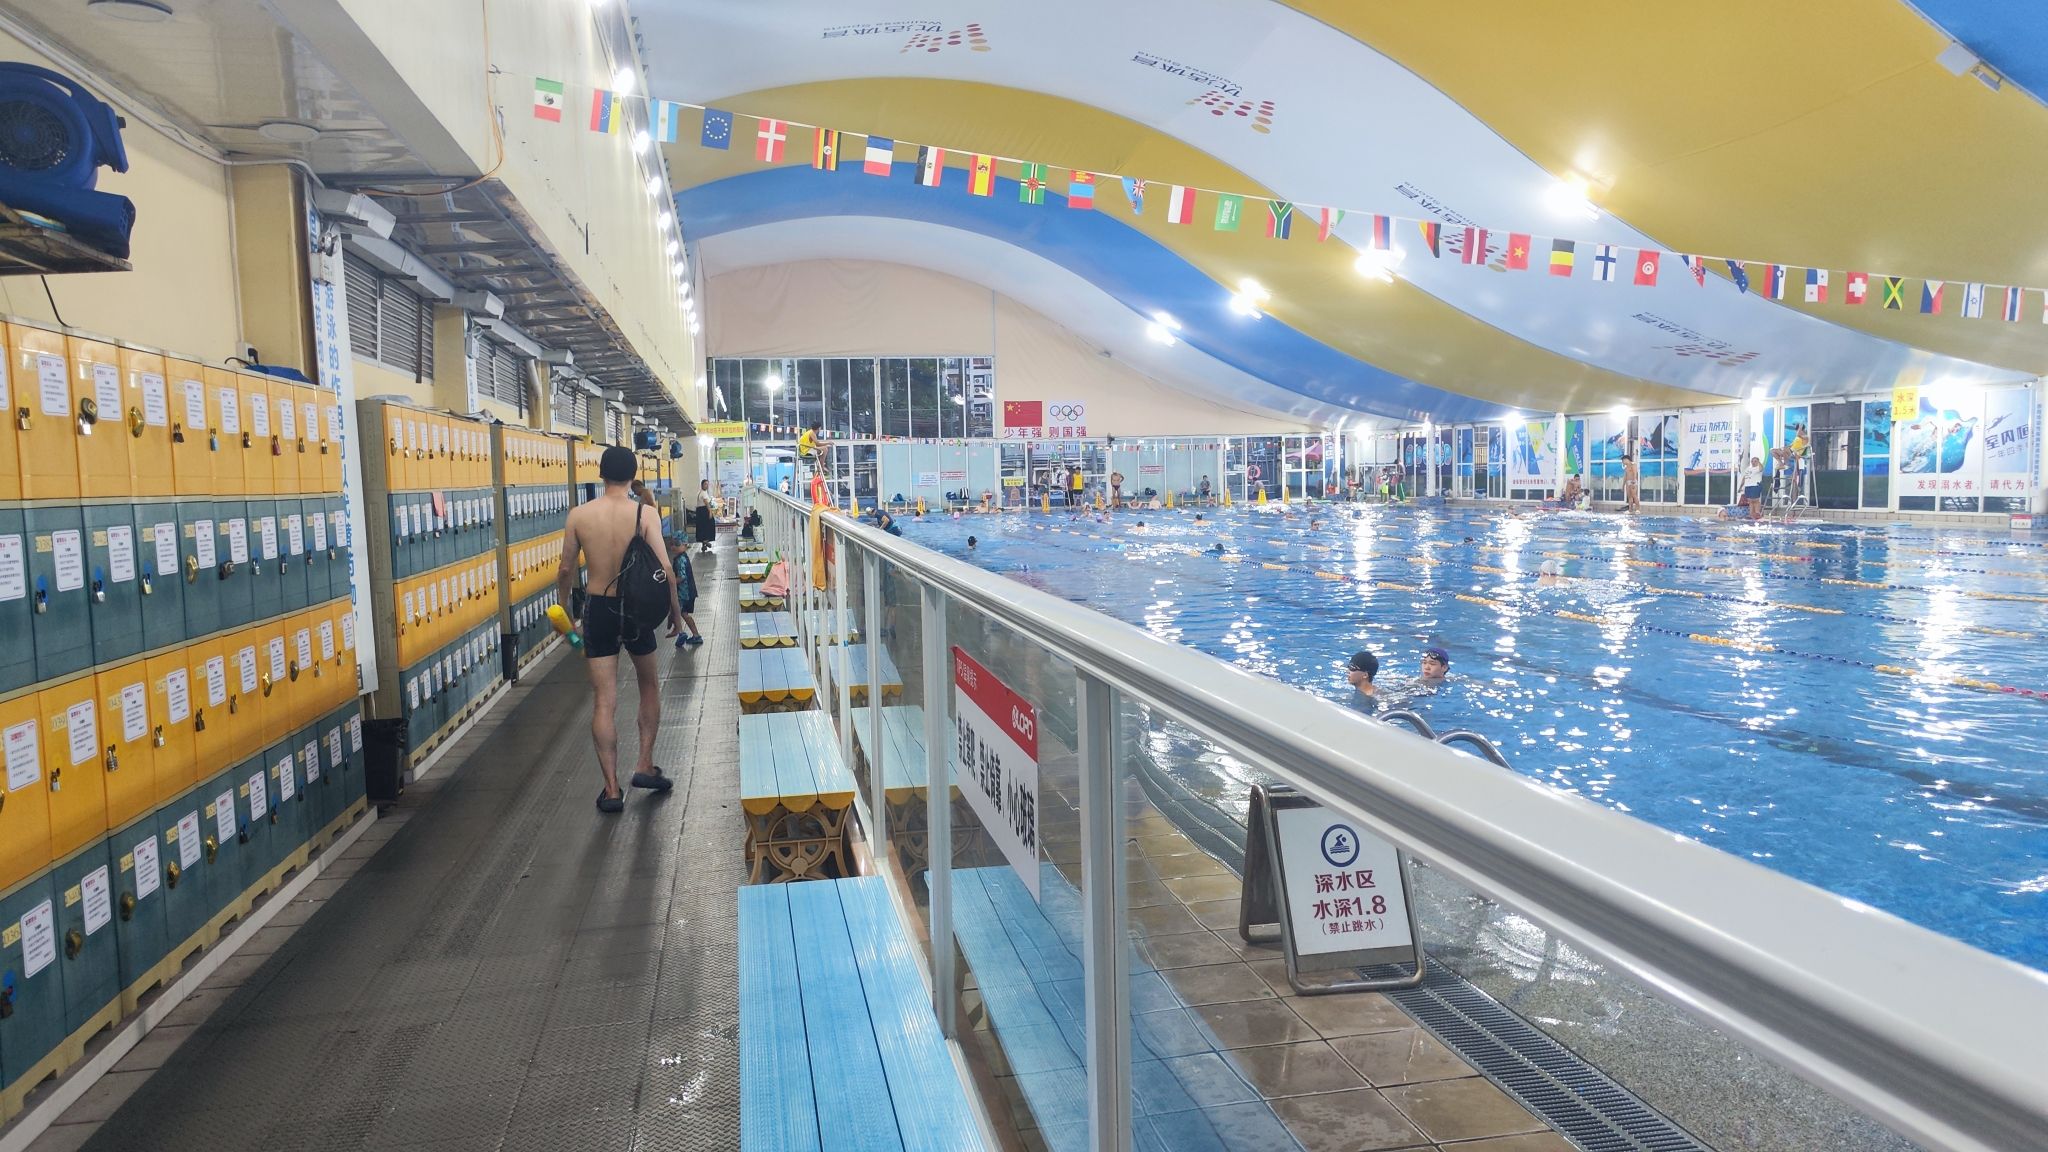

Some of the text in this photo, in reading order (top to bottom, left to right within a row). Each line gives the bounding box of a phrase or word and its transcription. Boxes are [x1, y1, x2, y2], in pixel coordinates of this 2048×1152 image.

[1314, 870, 1377, 894] 深水区
[1312, 895, 1387, 920] 水深1.8
